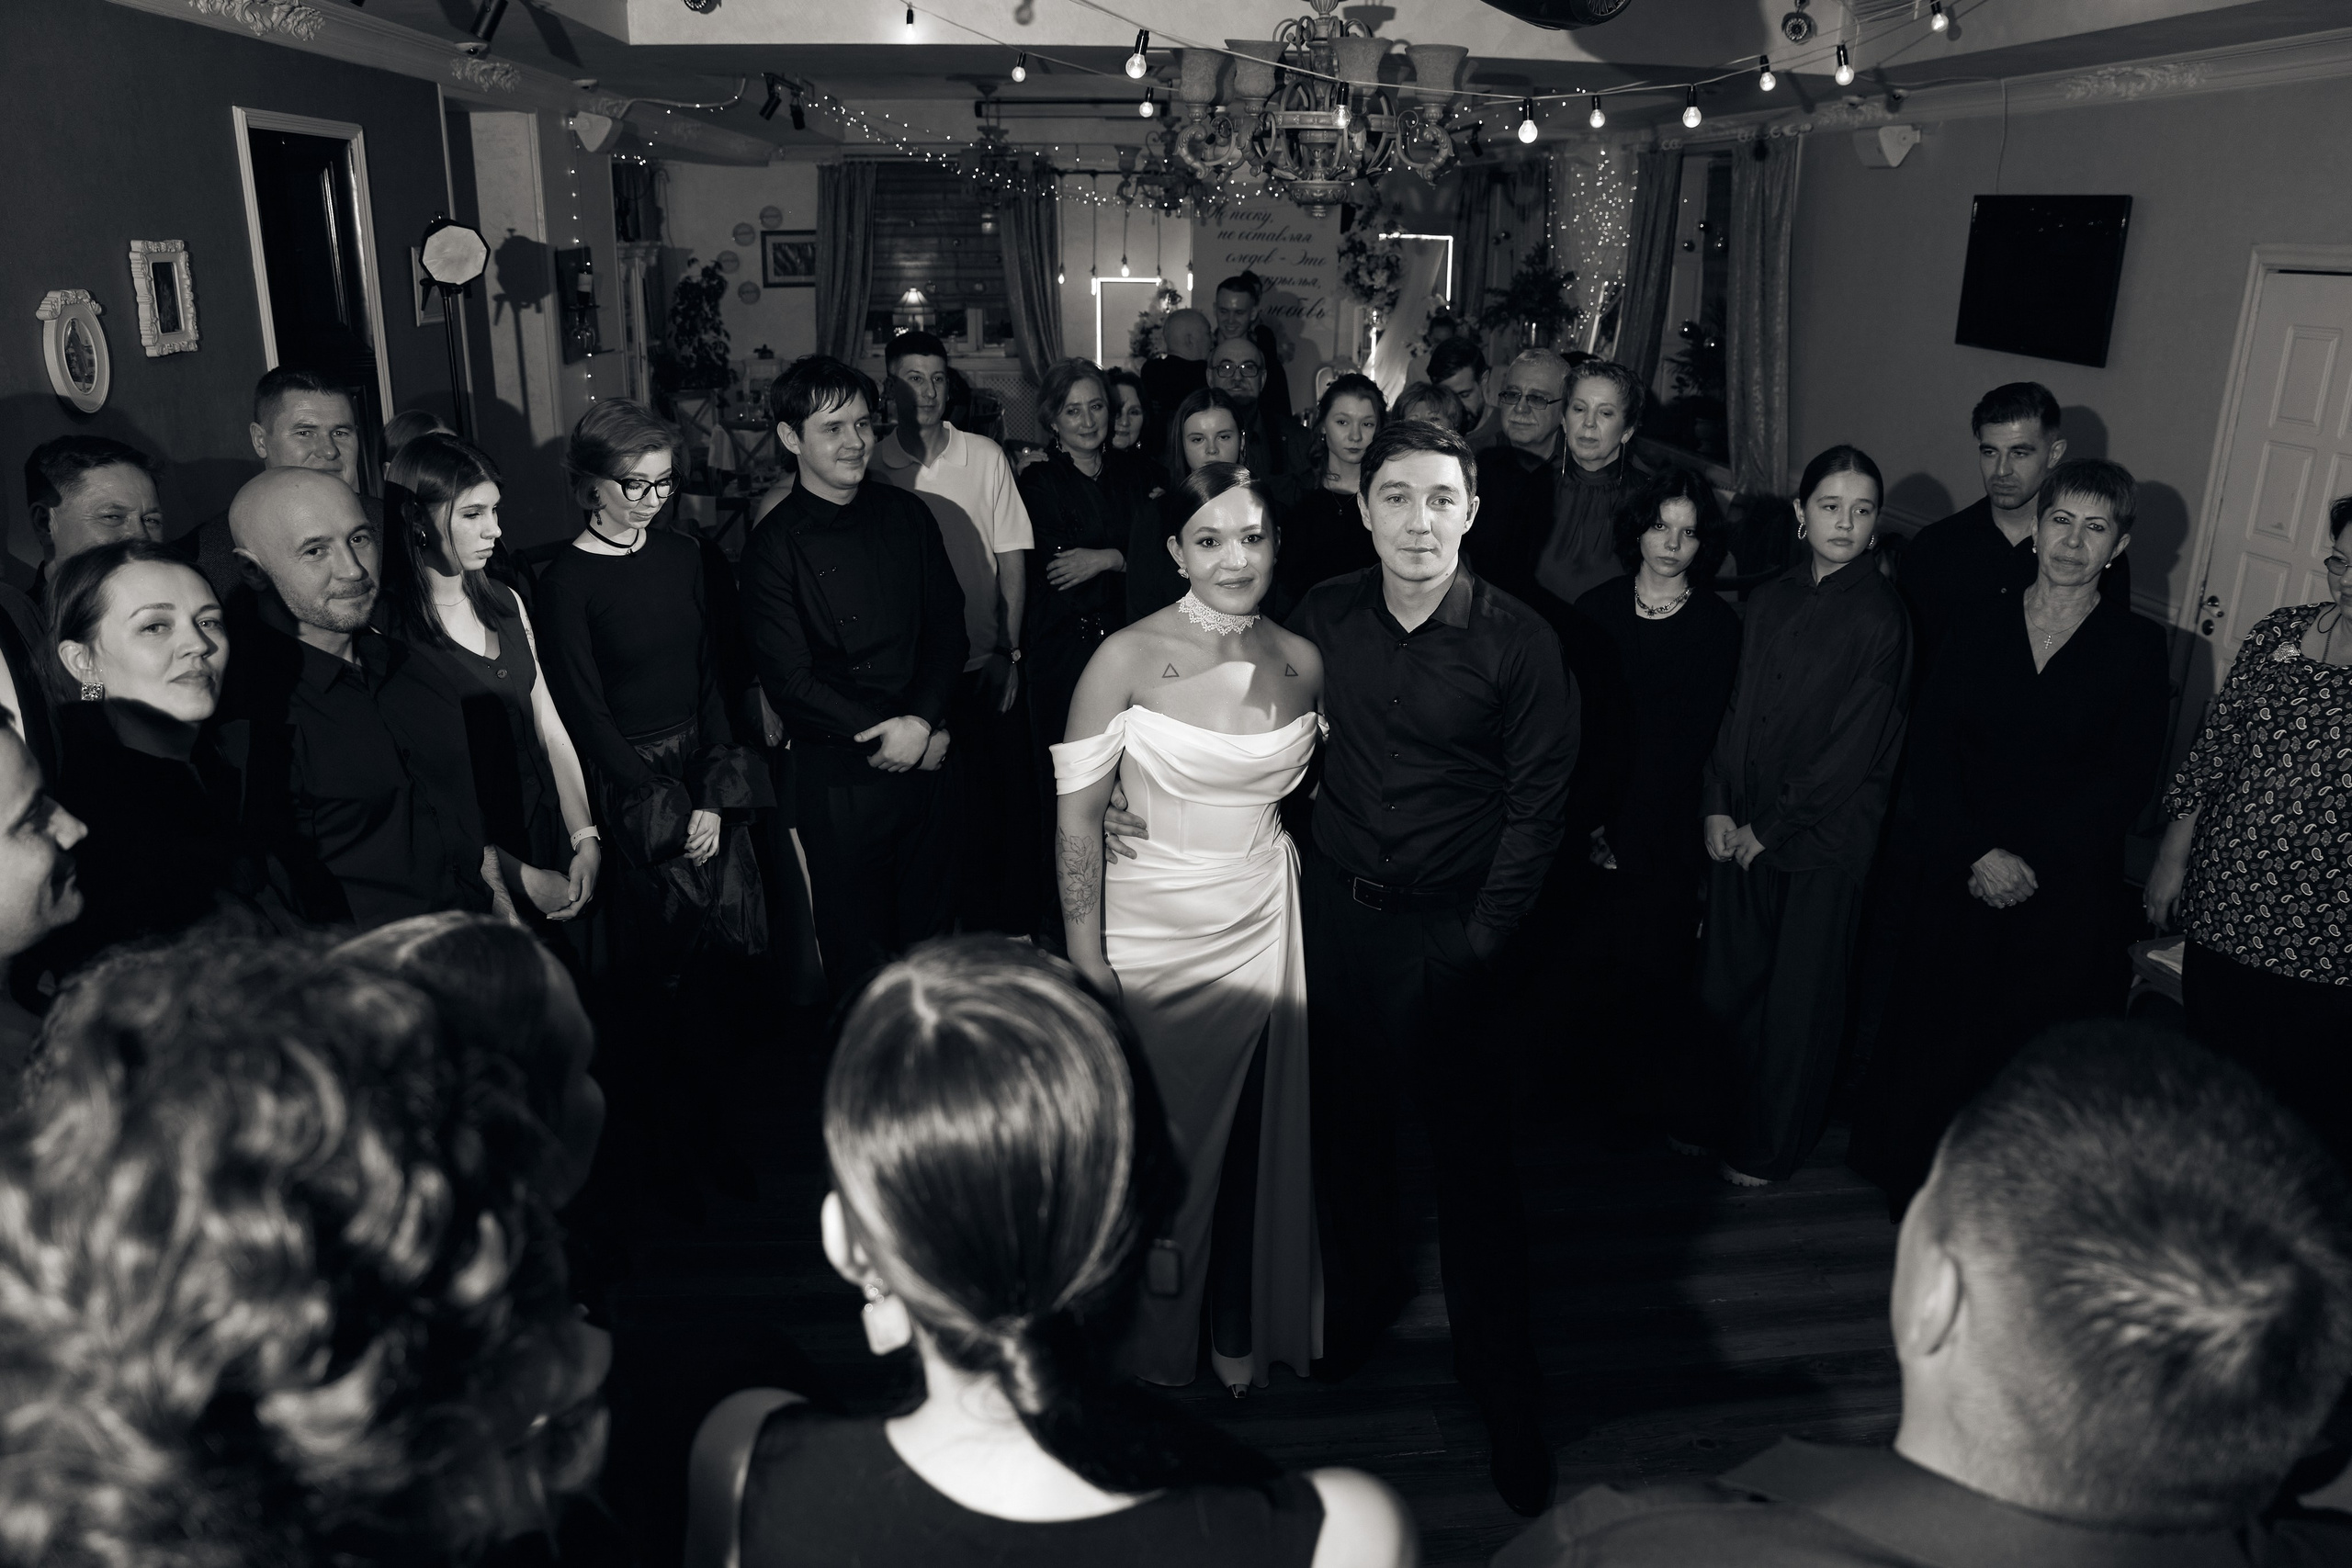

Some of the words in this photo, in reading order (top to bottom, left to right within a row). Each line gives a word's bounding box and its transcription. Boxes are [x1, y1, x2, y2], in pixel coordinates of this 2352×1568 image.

[1229, 209, 1274, 231] песку,
[1217, 230, 1236, 241] не
[1238, 225, 1313, 243] оставляя
[1226, 247, 1278, 272] следов
